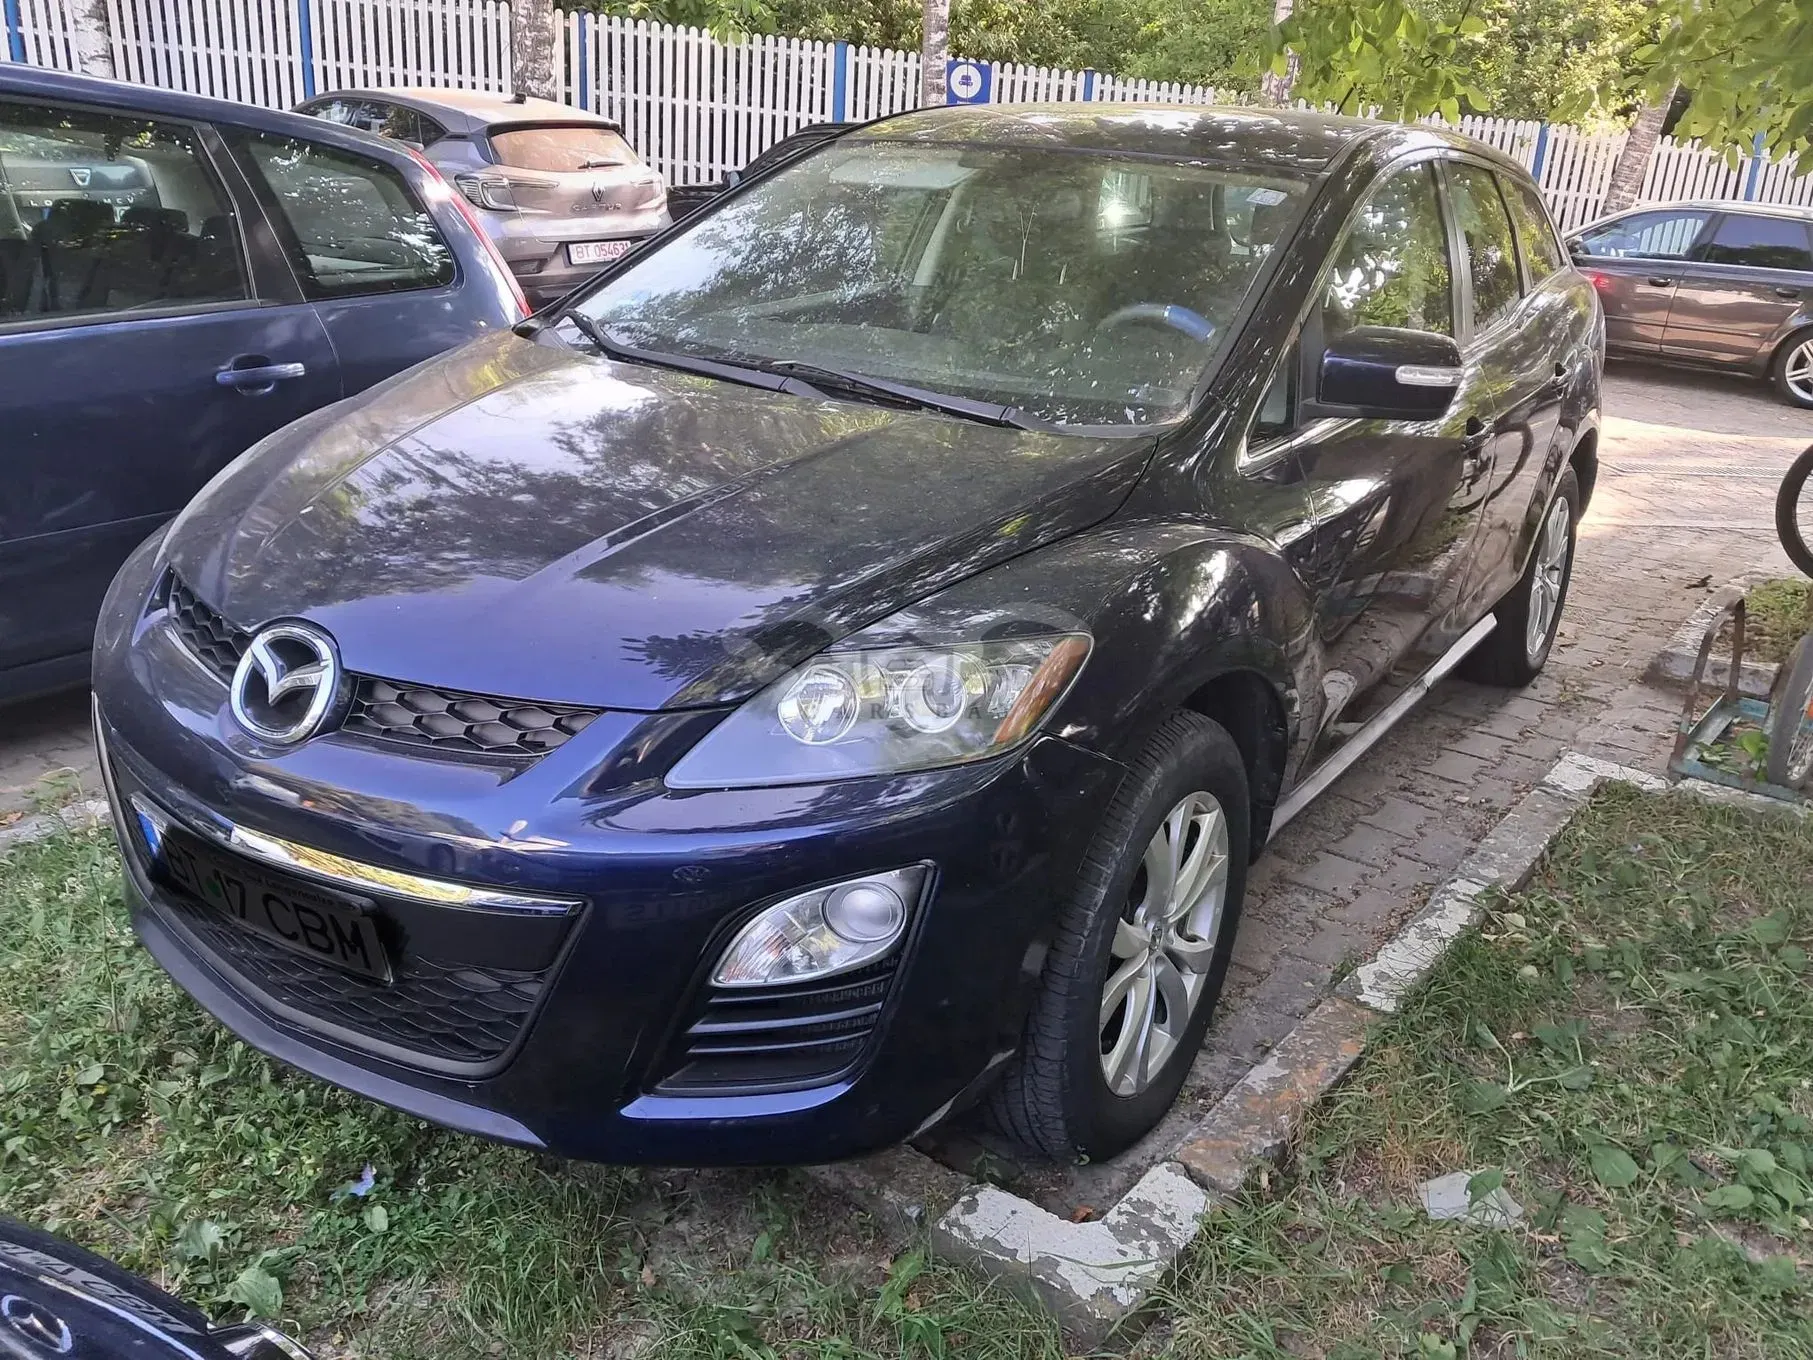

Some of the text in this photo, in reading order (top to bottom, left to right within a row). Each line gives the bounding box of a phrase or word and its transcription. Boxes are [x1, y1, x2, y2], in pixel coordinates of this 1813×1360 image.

[575, 245, 592, 259] BT
[212, 867, 248, 920] 17
[261, 892, 374, 970] CBM
